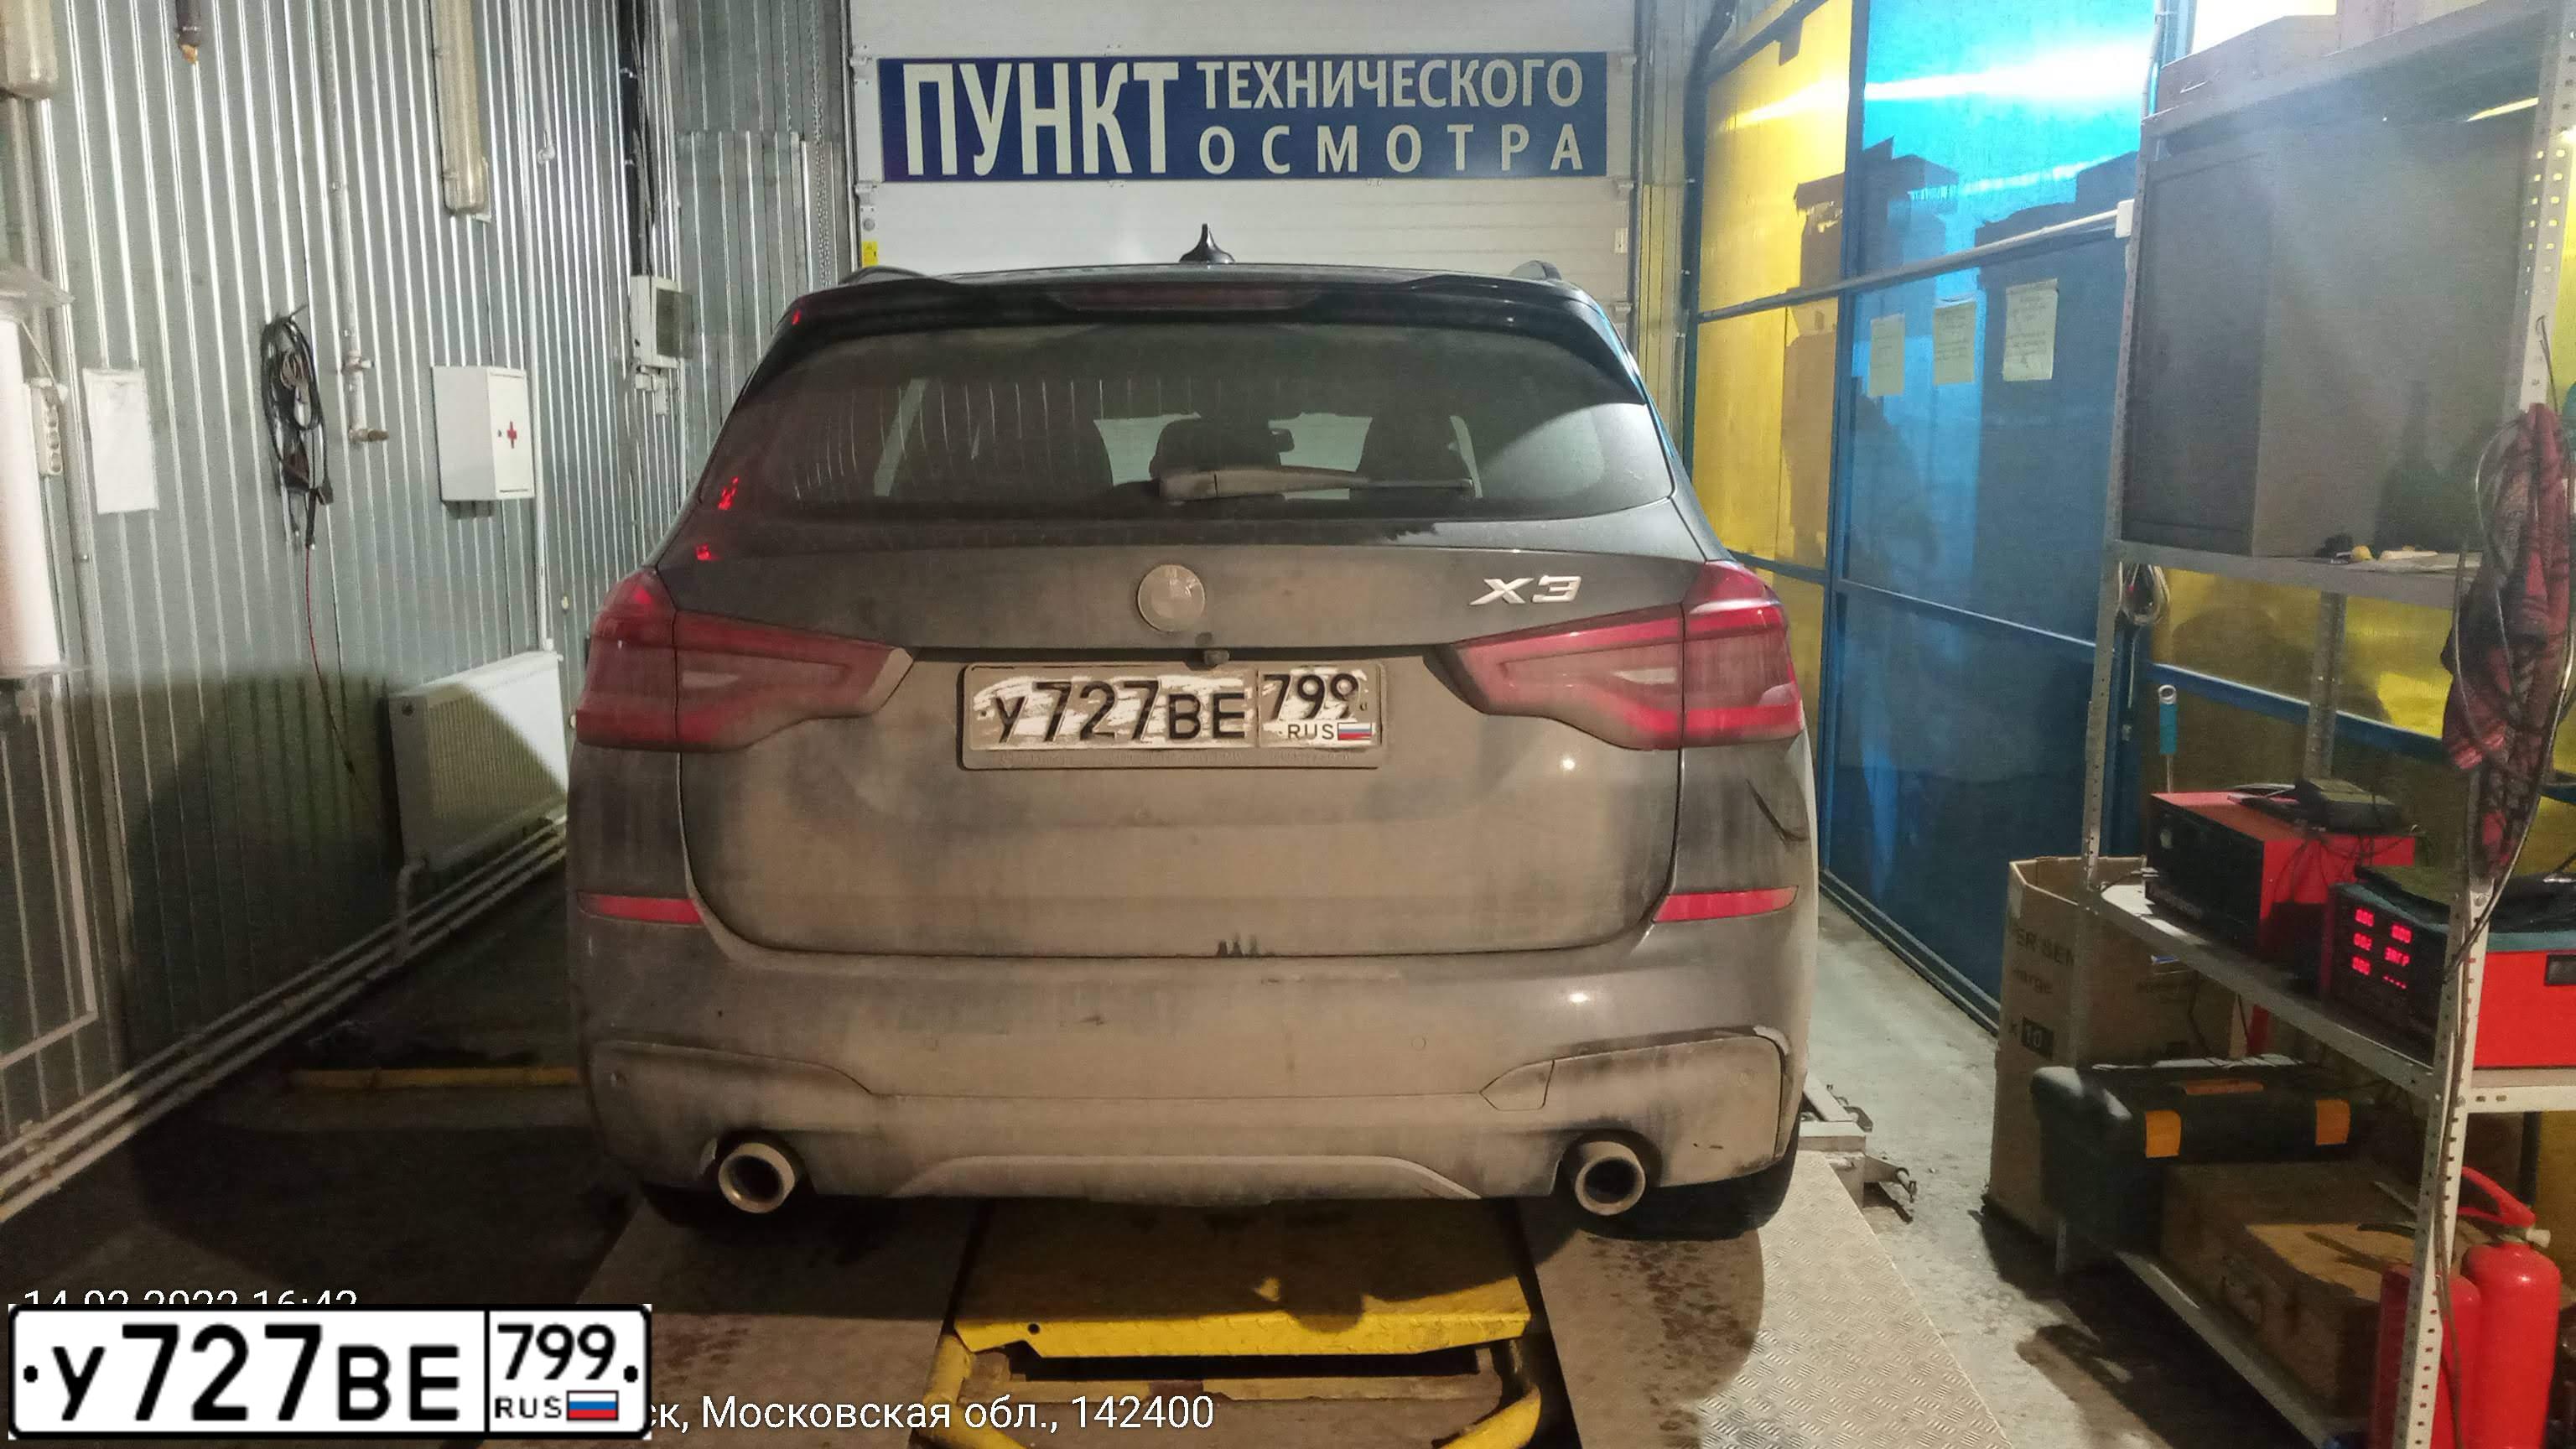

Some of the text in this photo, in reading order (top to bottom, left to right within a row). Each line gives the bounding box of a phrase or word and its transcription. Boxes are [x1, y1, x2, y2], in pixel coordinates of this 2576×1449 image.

[1197, 59, 1583, 109] ТЕХНИЧЕСКОГО
[903, 62, 1180, 175] ПУНКТ
[1199, 123, 1583, 174] ОСМОТРА
[1468, 574, 1582, 606] X3
[1263, 673, 1360, 720] 799
[1287, 723, 1335, 740] RUS
